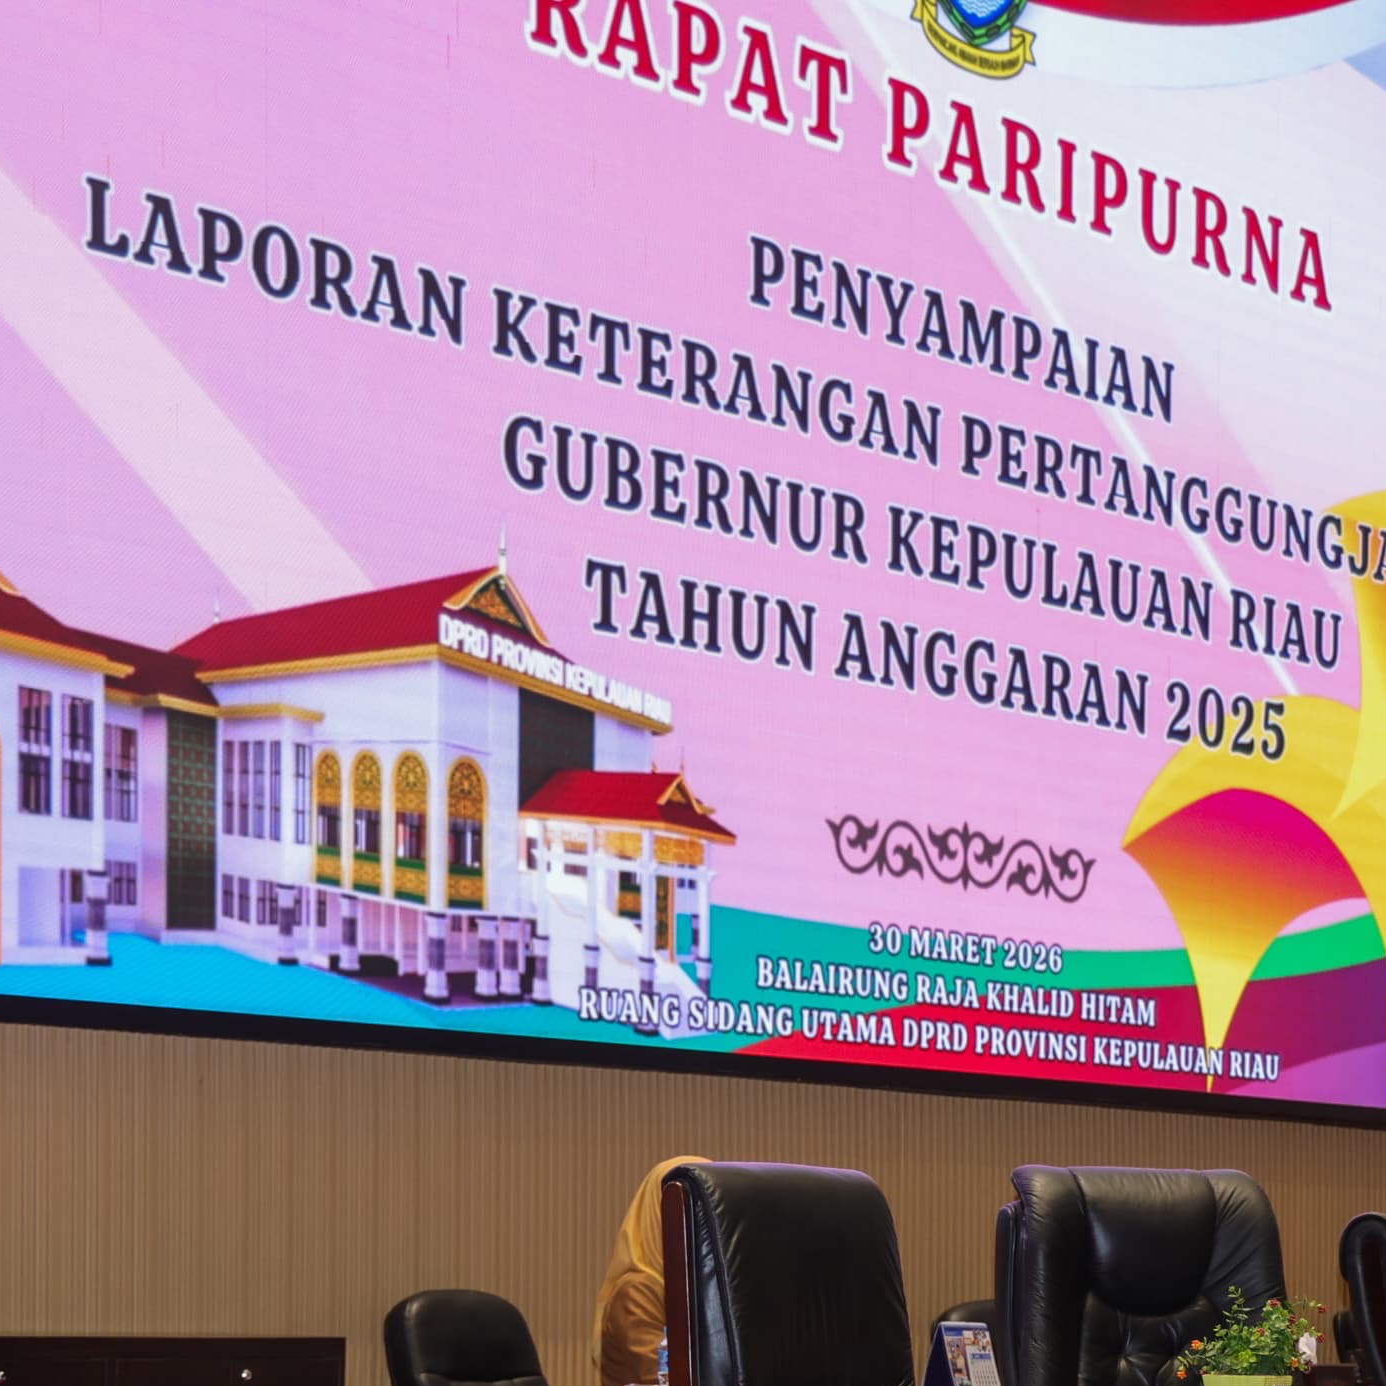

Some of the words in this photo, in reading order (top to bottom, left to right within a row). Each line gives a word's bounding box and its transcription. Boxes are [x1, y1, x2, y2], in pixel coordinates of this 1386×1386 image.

[888, 77, 1333, 312] PARIPURNA
[86, 177, 466, 346] LAPORAN
[493, 289, 941, 467] KETERANGAN
[750, 237, 1175, 423] PENYAMPAIAN
[504, 416, 867, 564] GUBERNUR
[888, 505, 1213, 640] KEPULAUAN
[1229, 590, 1342, 670] RIAU
[440, 614, 488, 658] DPRD
[491, 635, 564, 686] PROVINSI
[585, 559, 816, 671] TAHUN
[835, 613, 1149, 737] ANGGARAN
[1167, 685, 1287, 760] 2025
[579, 988, 680, 1026] RUANG
[689, 998, 794, 1037] SIDANG
[802, 1008, 896, 1047] UTAMA
[903, 1019, 968, 1052] DPRD
[975, 1026, 1087, 1064] PROVINSI
[1094, 1037, 1224, 1076] KEPULAUAN
[1230, 1052, 1280, 1081] RIAU
[758, 957, 908, 1001] BALAIRUNG
[917, 975, 980, 1008] RAJA
[987, 982, 1074, 1018] KHALID
[1081, 992, 1156, 1027] HITAM
[869, 922, 902, 954] 30
[910, 929, 997, 965] MARET
[1004, 941, 1063, 973] 2026
